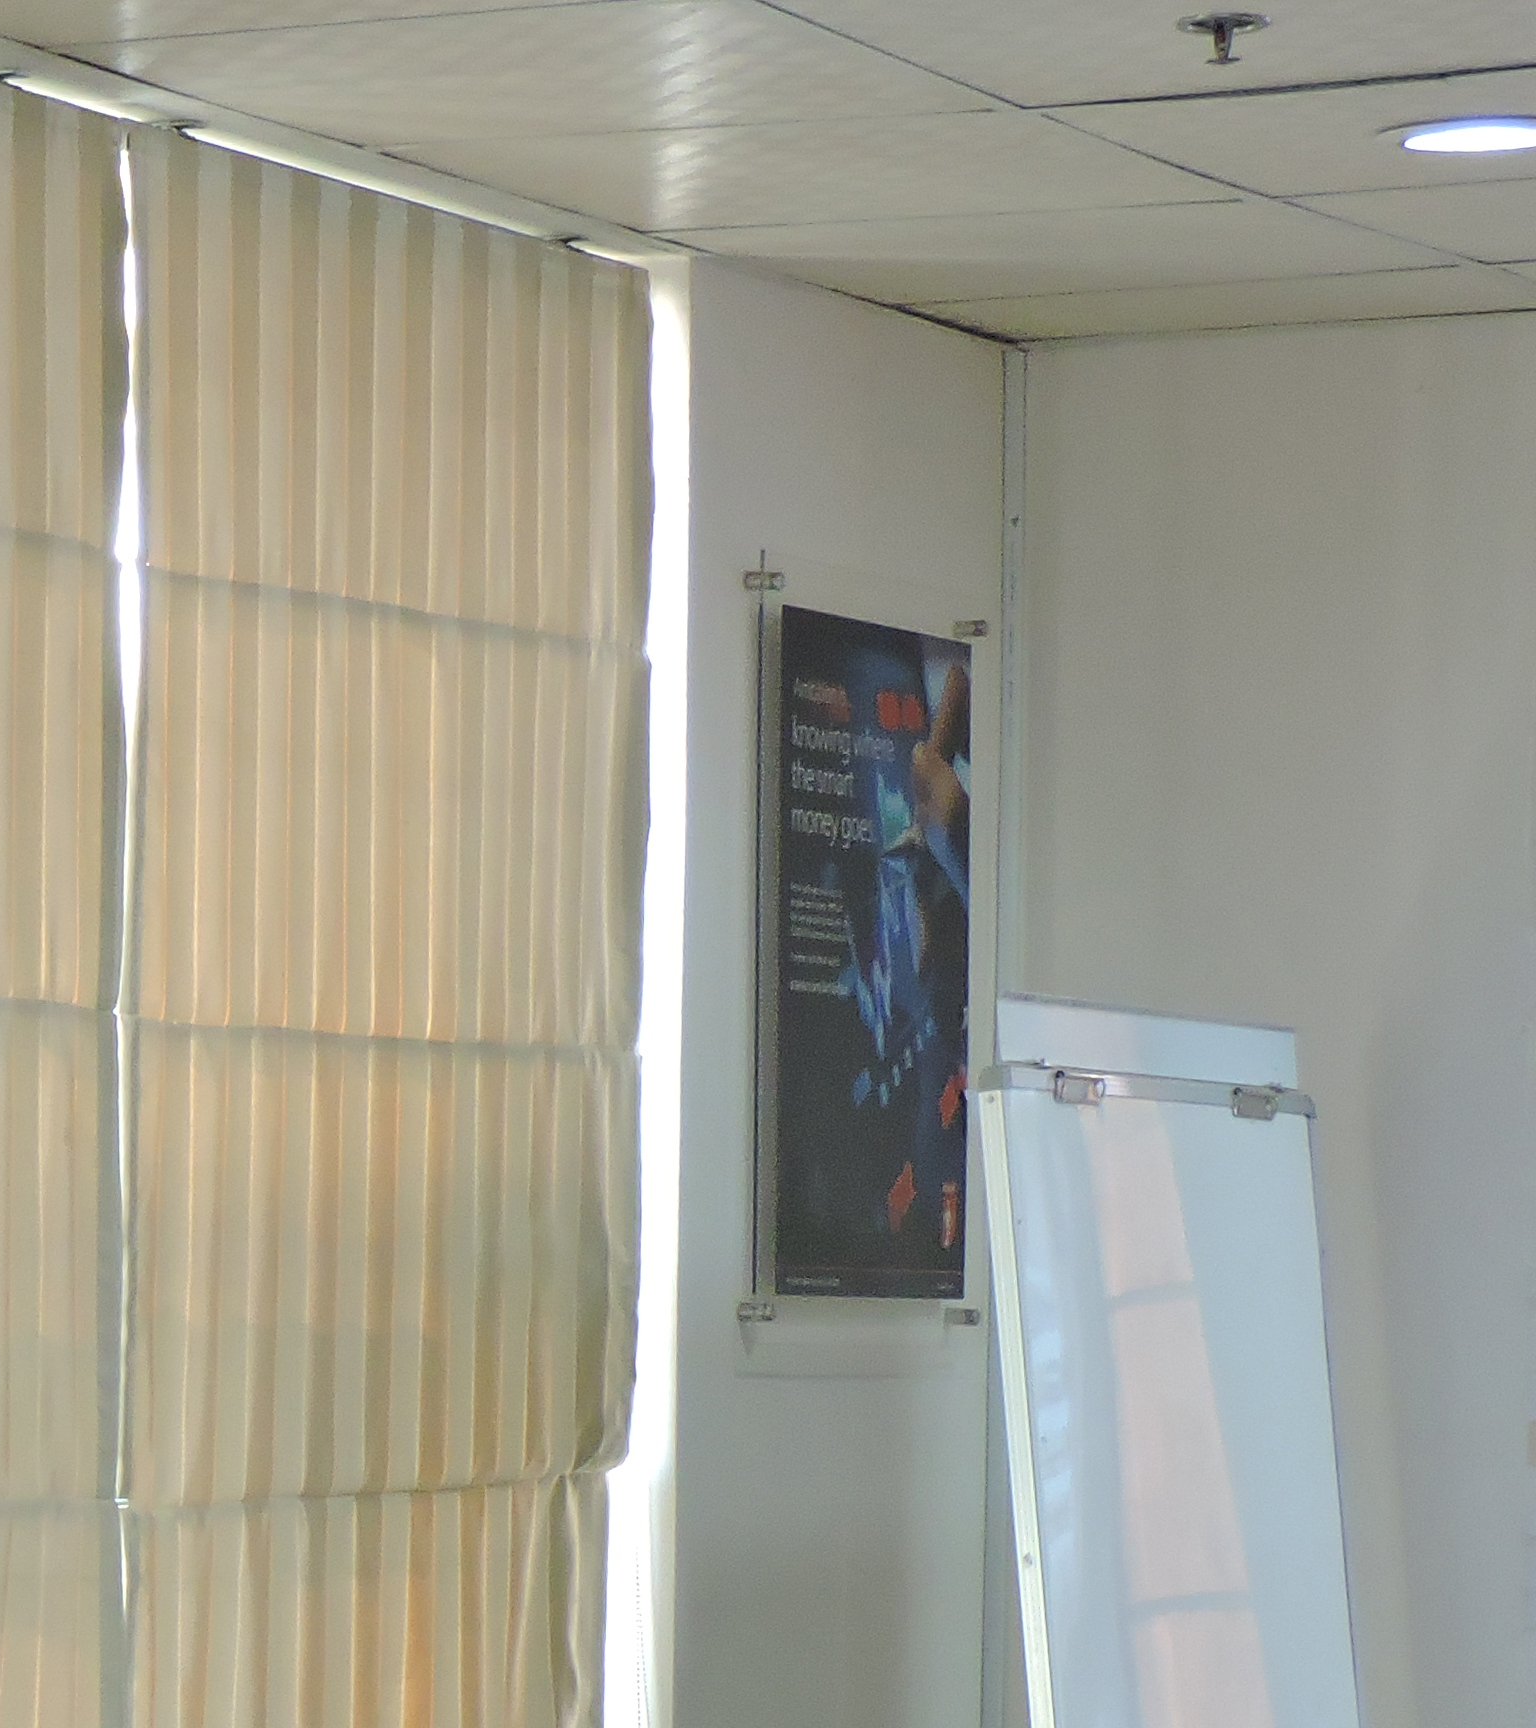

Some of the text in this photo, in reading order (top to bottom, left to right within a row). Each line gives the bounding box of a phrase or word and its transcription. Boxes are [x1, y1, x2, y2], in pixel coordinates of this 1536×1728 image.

[792, 715, 850, 765] knowing
[791, 759, 855, 798] the smart
[791, 808, 839, 847] money
